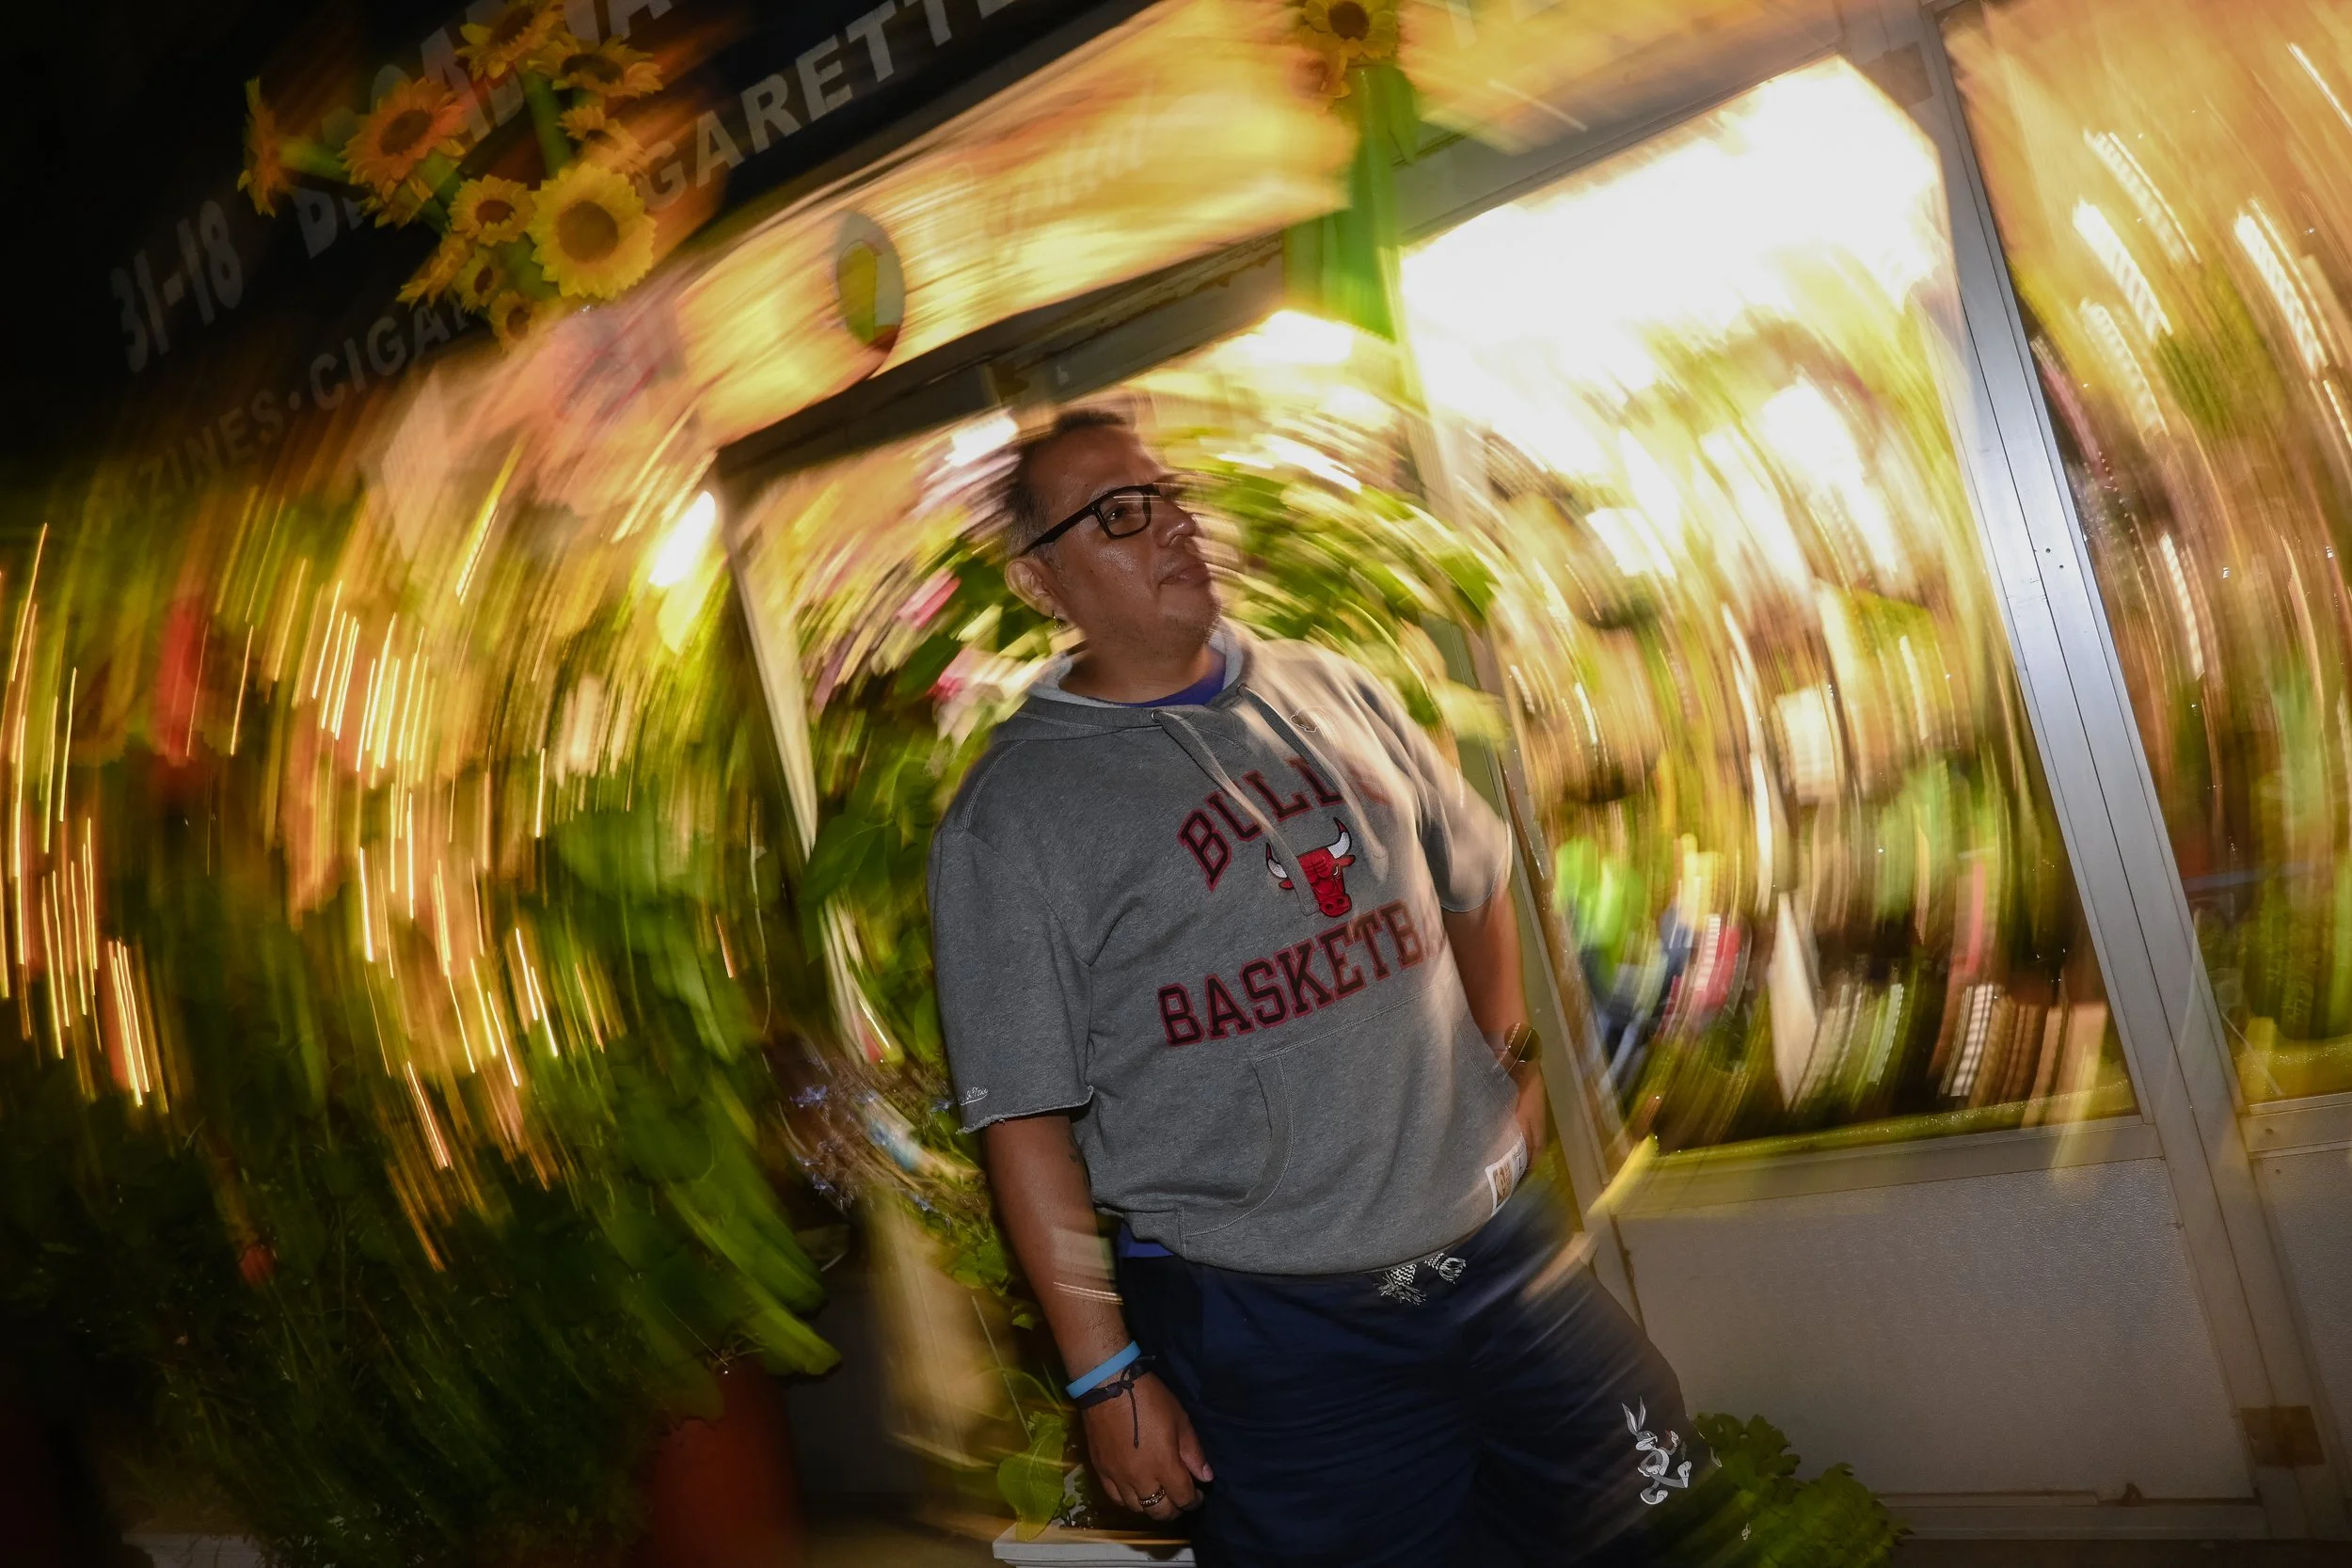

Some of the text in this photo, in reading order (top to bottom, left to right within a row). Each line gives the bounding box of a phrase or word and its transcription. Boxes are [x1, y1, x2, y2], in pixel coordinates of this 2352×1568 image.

[109, 198, 245, 372] 31-18
[310, 295, 478, 410] CIGA
[1176, 752, 1391, 892] BULL
[1156, 899, 1434, 1047] BASKETB
